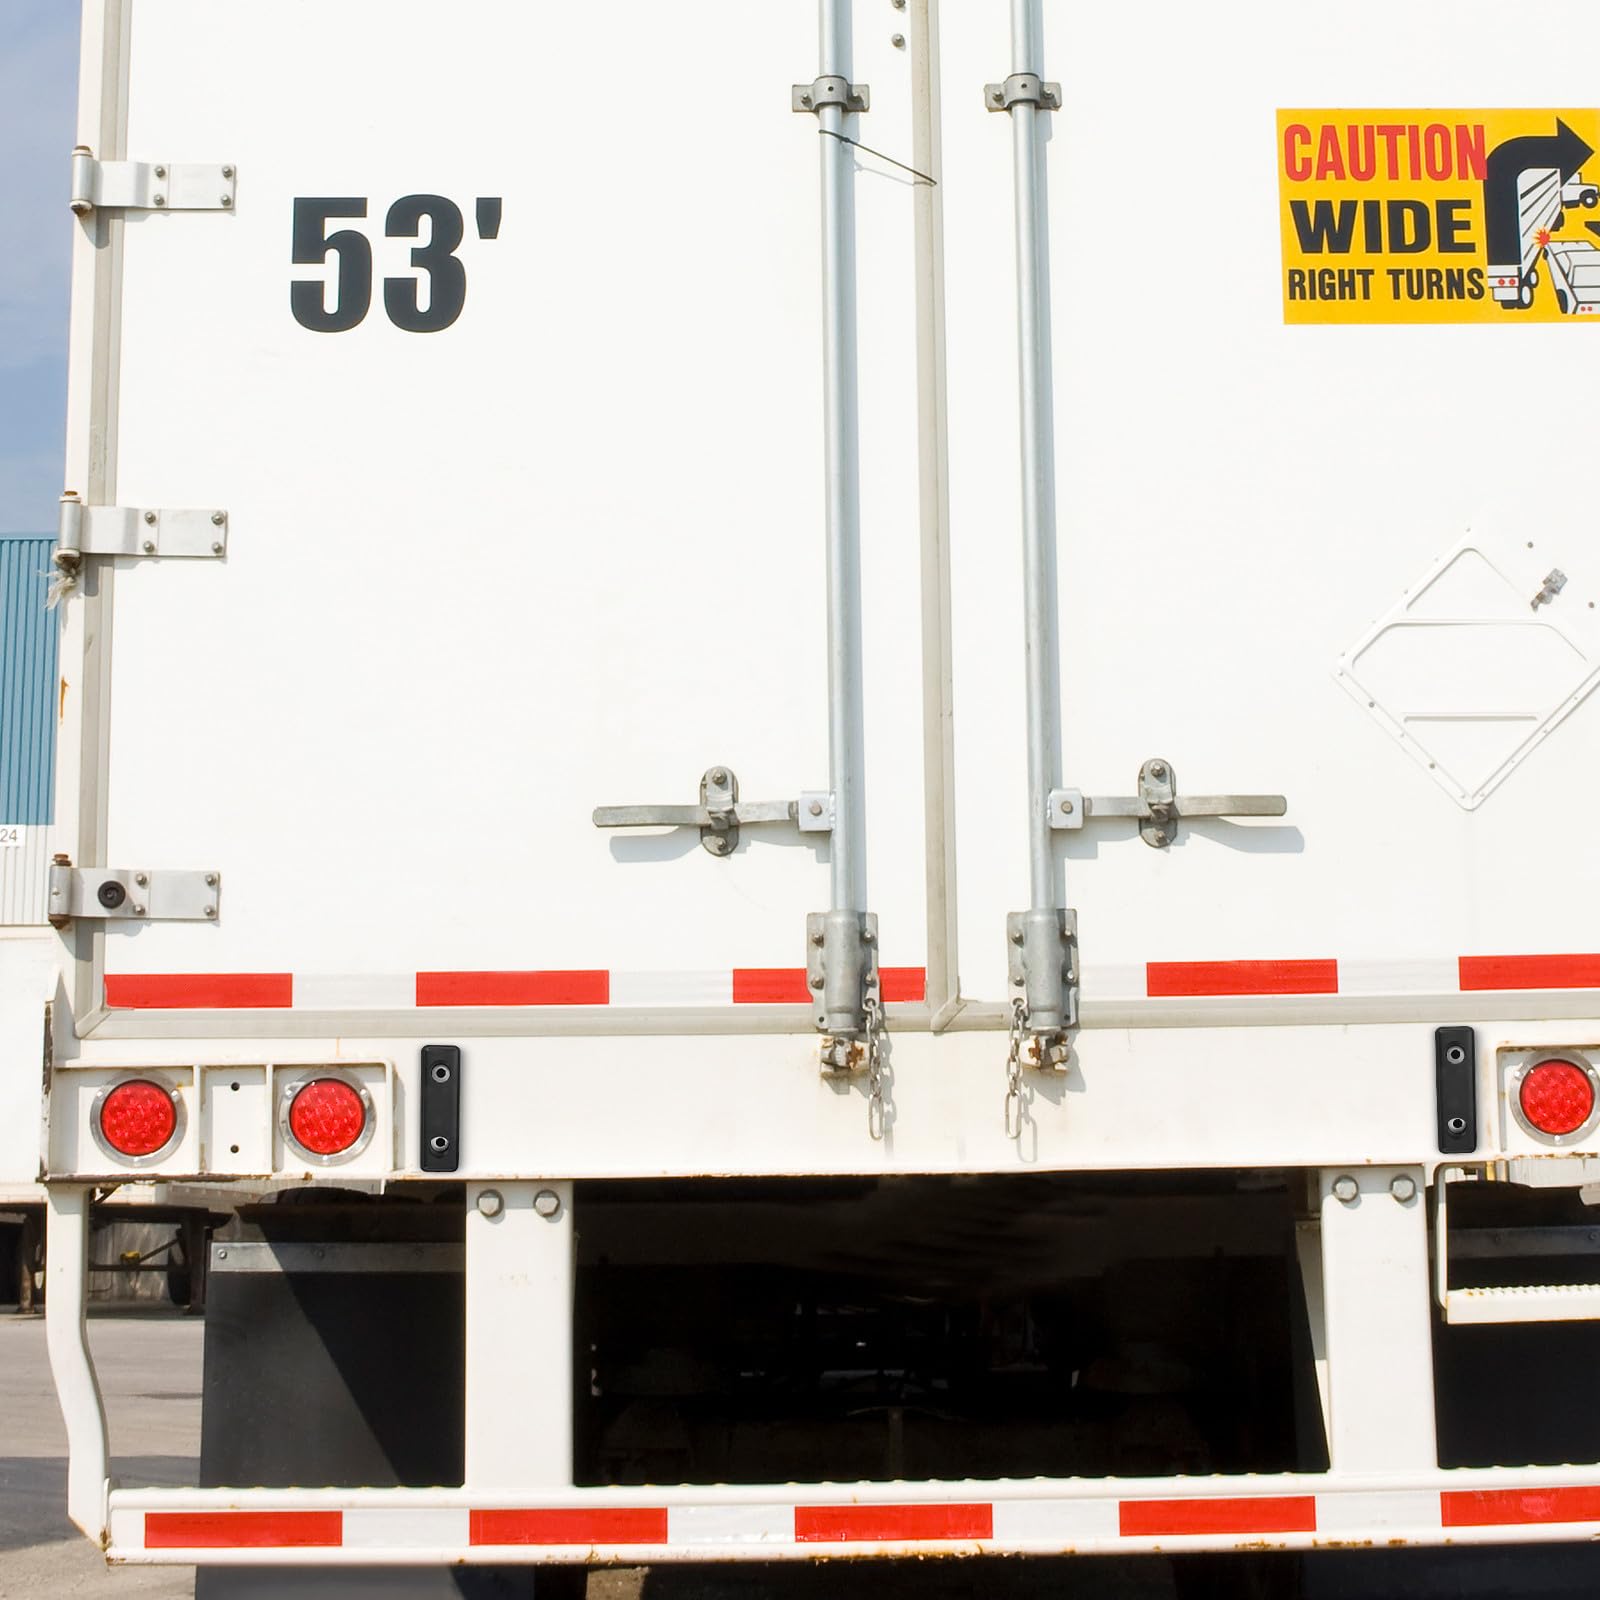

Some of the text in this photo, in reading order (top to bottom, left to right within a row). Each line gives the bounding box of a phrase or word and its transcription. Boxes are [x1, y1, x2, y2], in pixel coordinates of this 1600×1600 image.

[1284, 124, 1487, 181] CAUTION
[1290, 200, 1476, 253] WIDE
[291, 194, 502, 333] 53'
[1289, 268, 1485, 300] RIGHT TURNS
